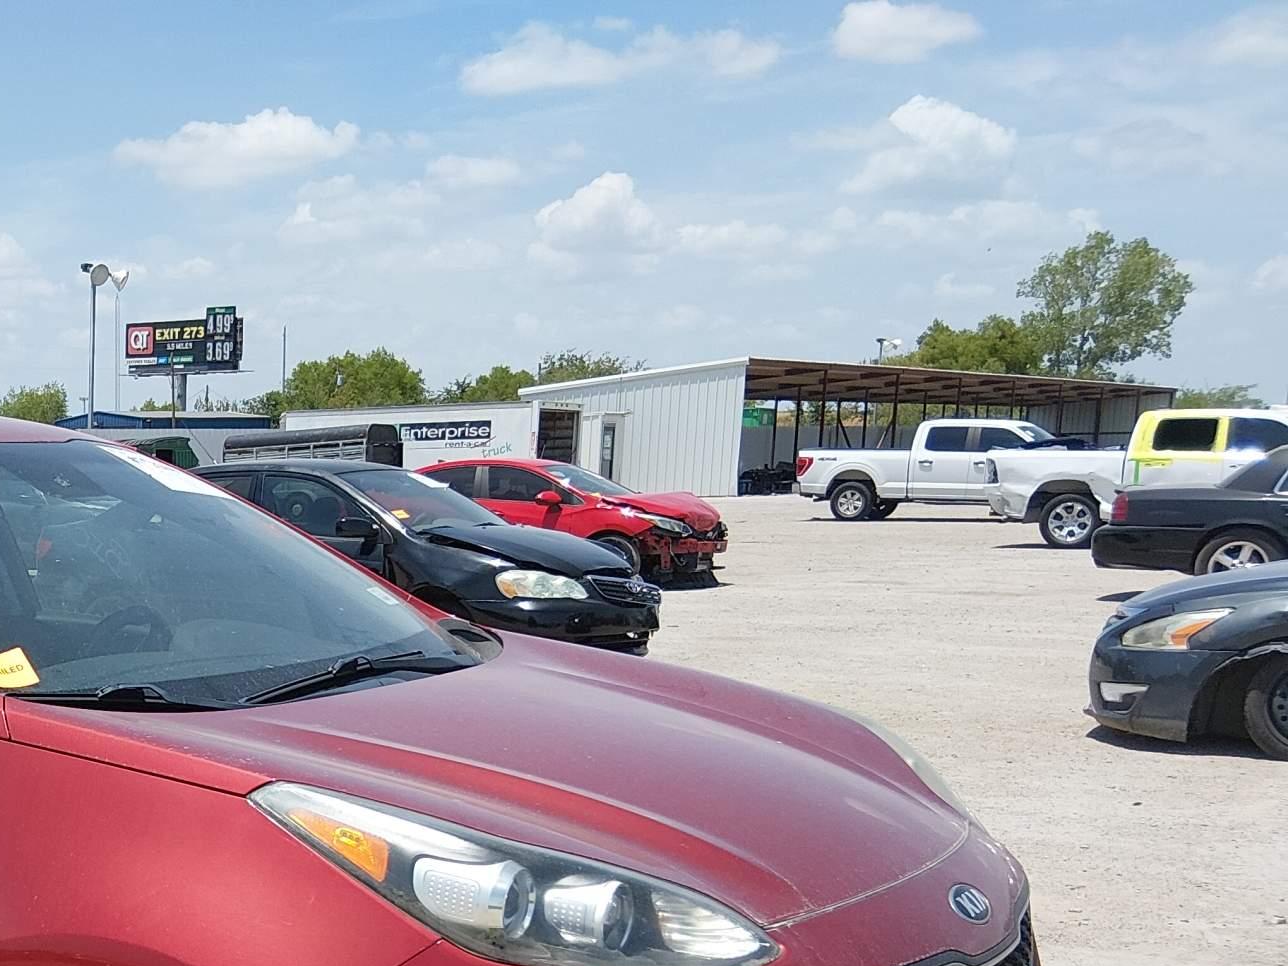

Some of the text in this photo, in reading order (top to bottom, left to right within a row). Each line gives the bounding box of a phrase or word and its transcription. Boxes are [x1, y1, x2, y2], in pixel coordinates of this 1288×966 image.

[130, 331, 149, 351] QT
[155, 326, 205, 340] EXIT 273
[400, 423, 490, 440] Enterprise
[482, 441, 512, 458] truck
[955, 888, 986, 917] KIA
